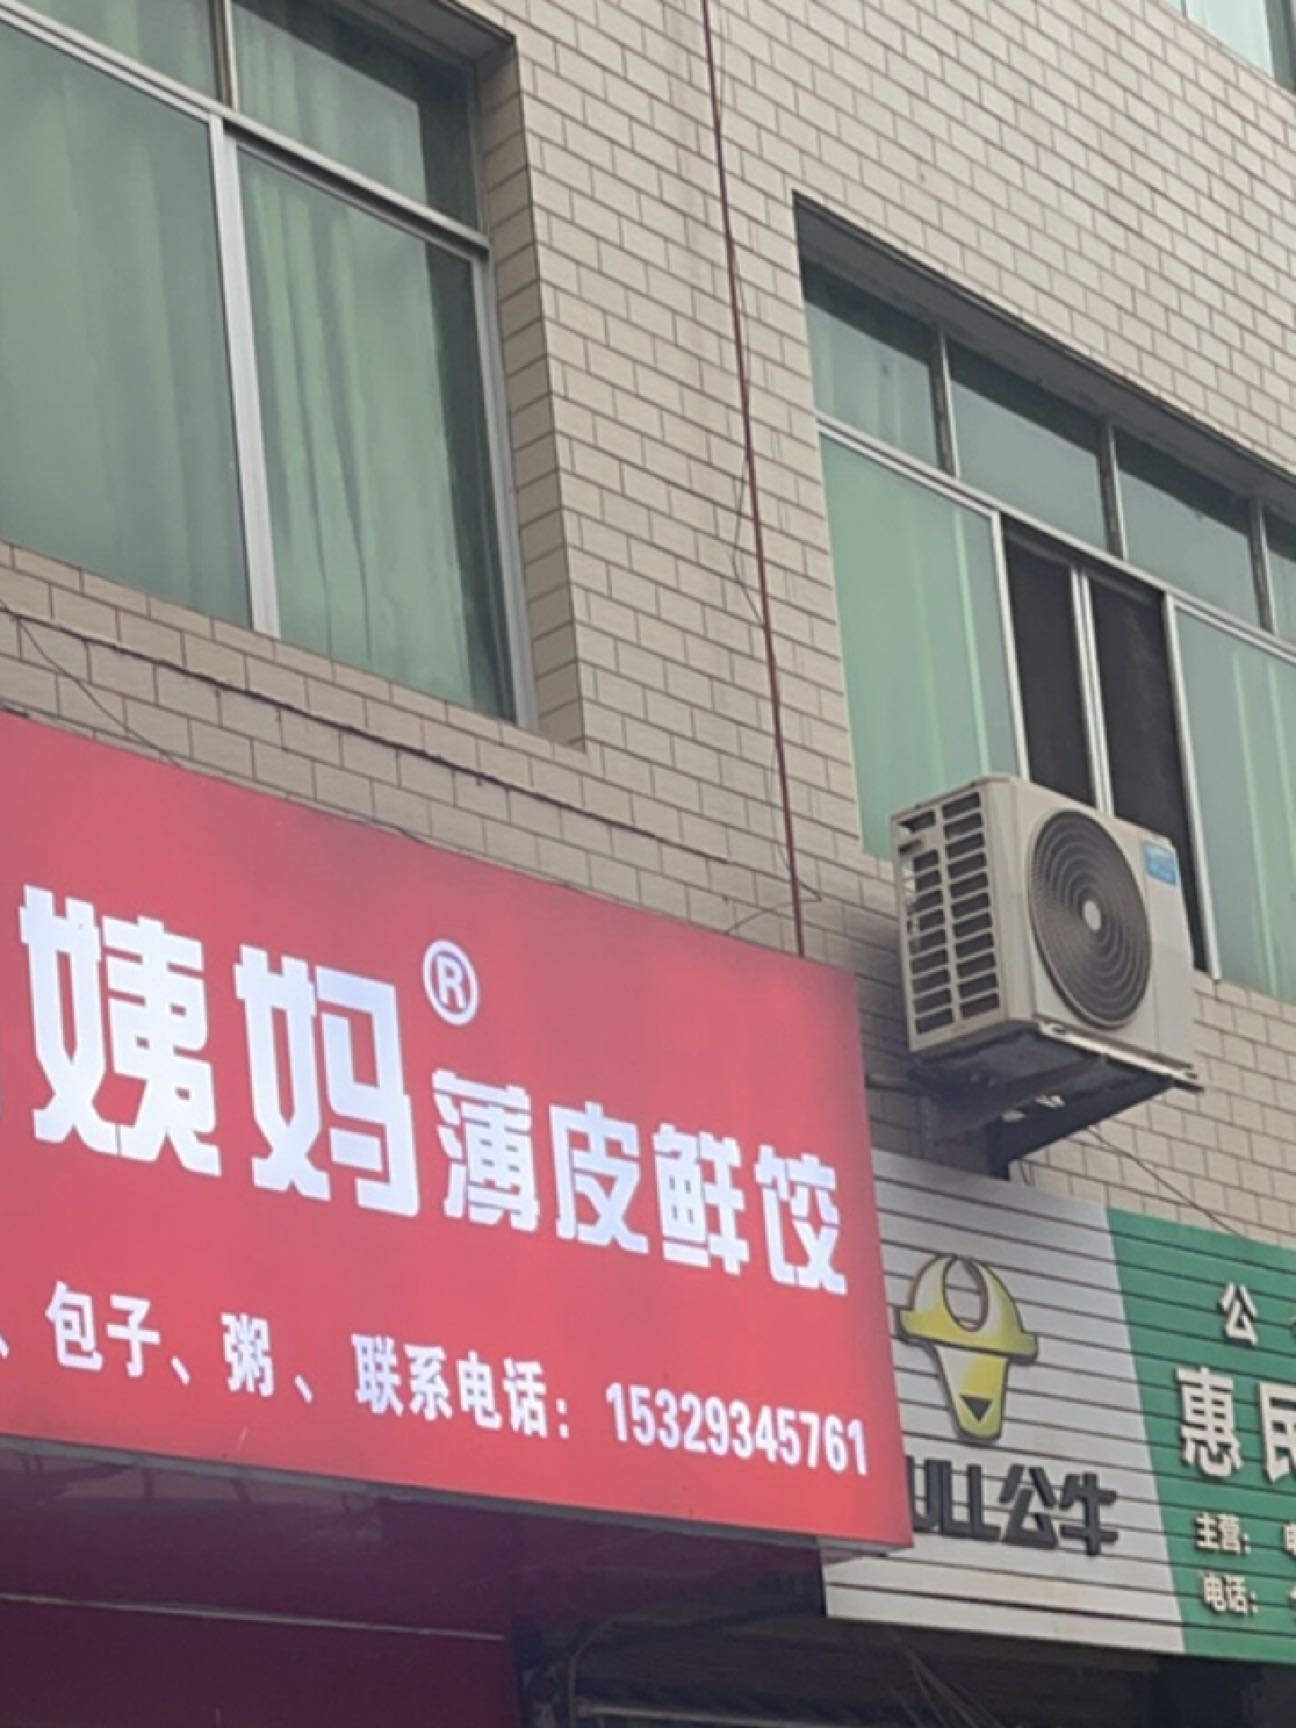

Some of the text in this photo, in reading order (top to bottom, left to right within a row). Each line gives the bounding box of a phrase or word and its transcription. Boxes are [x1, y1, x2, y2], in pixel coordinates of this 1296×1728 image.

[432, 1069, 848, 1295] 薄皮鲜饺
[1218, 1281, 1259, 1346] 公
[605, 1382, 868, 1476] 15329345761
